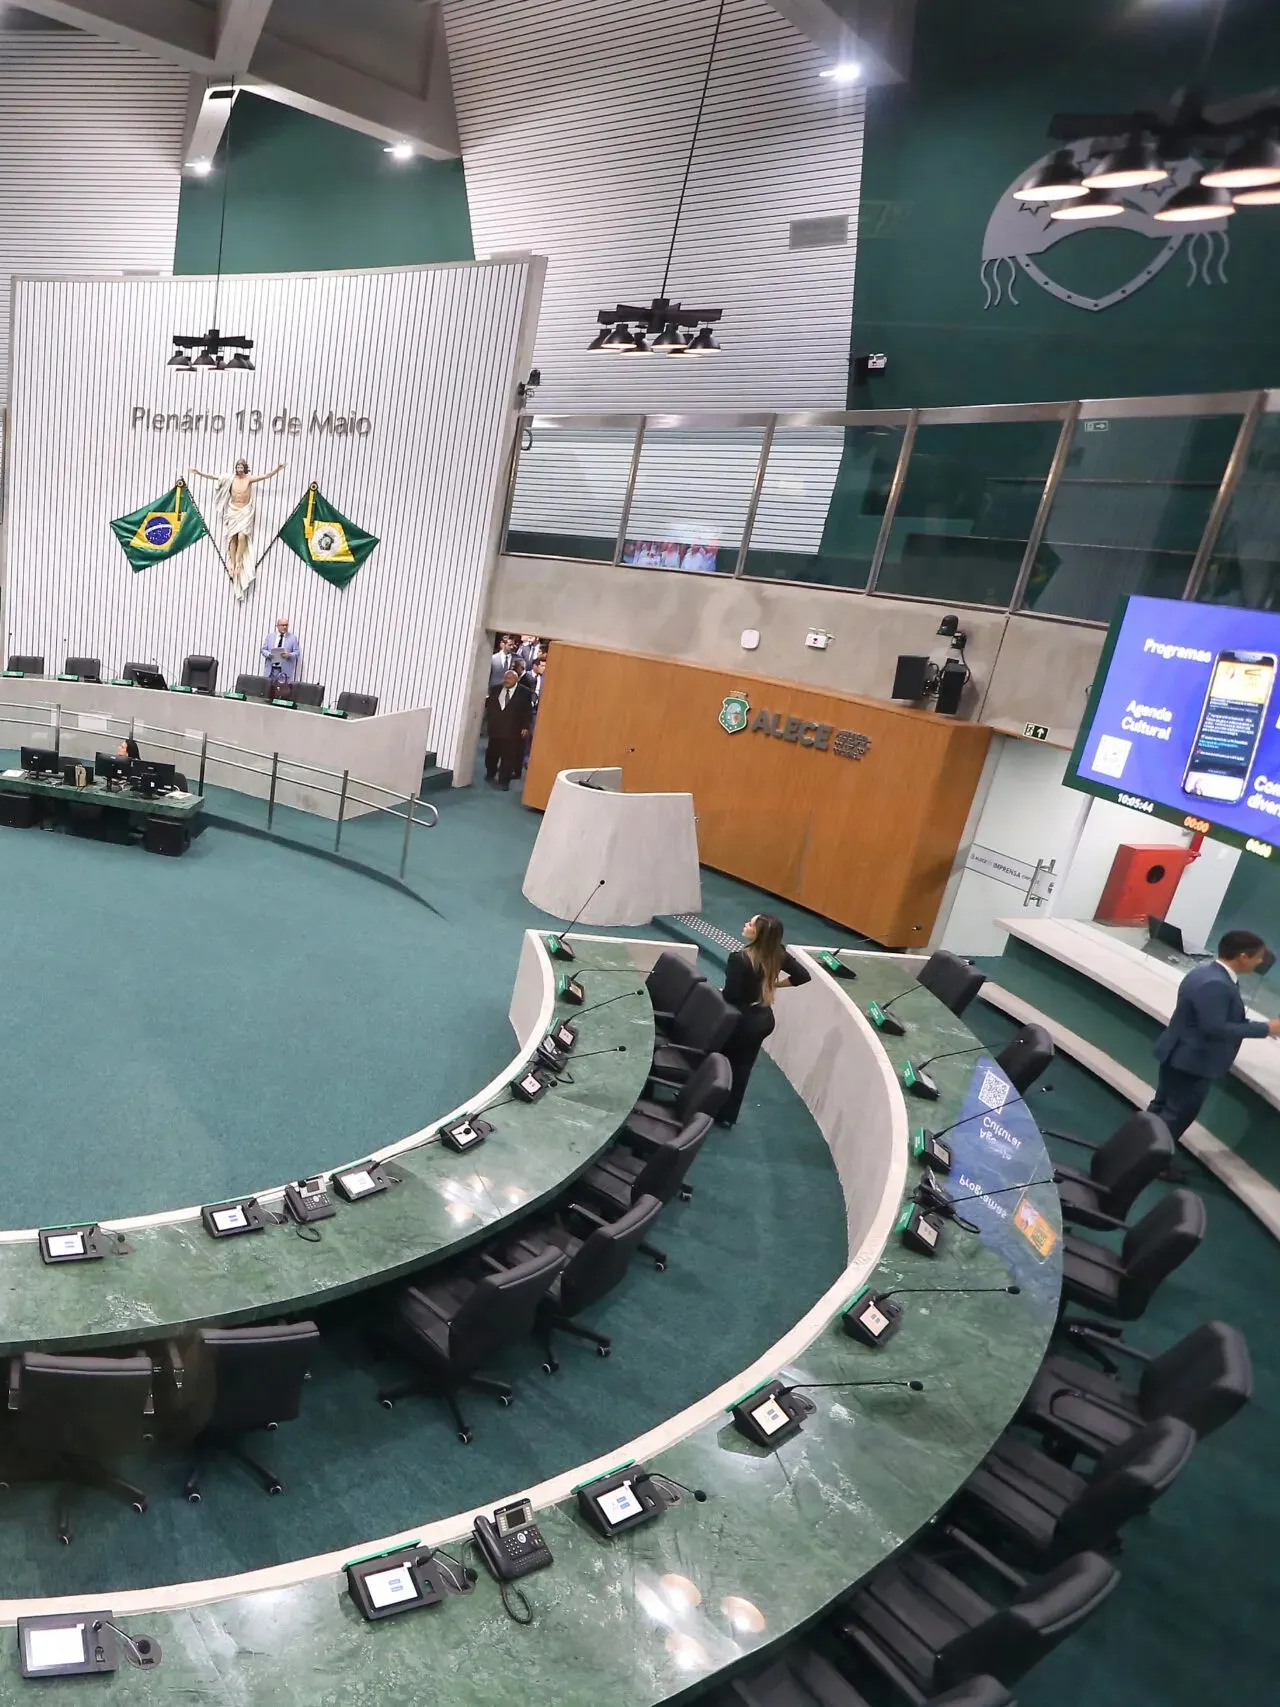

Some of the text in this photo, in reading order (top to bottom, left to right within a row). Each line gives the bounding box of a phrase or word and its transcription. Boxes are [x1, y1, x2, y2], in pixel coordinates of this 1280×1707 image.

[131, 406, 373, 436] Plenário 13 de Maio
[1143, 638, 1212, 663] Programas
[1126, 700, 1173, 722] Agenda
[752, 709, 834, 752] ALECE
[1121, 717, 1173, 741] Cultural
[1117, 793, 1154, 813] 10:05:44
[1183, 815, 1210, 834] 00:00
[993, 861, 1022, 879] IMPRENSA
